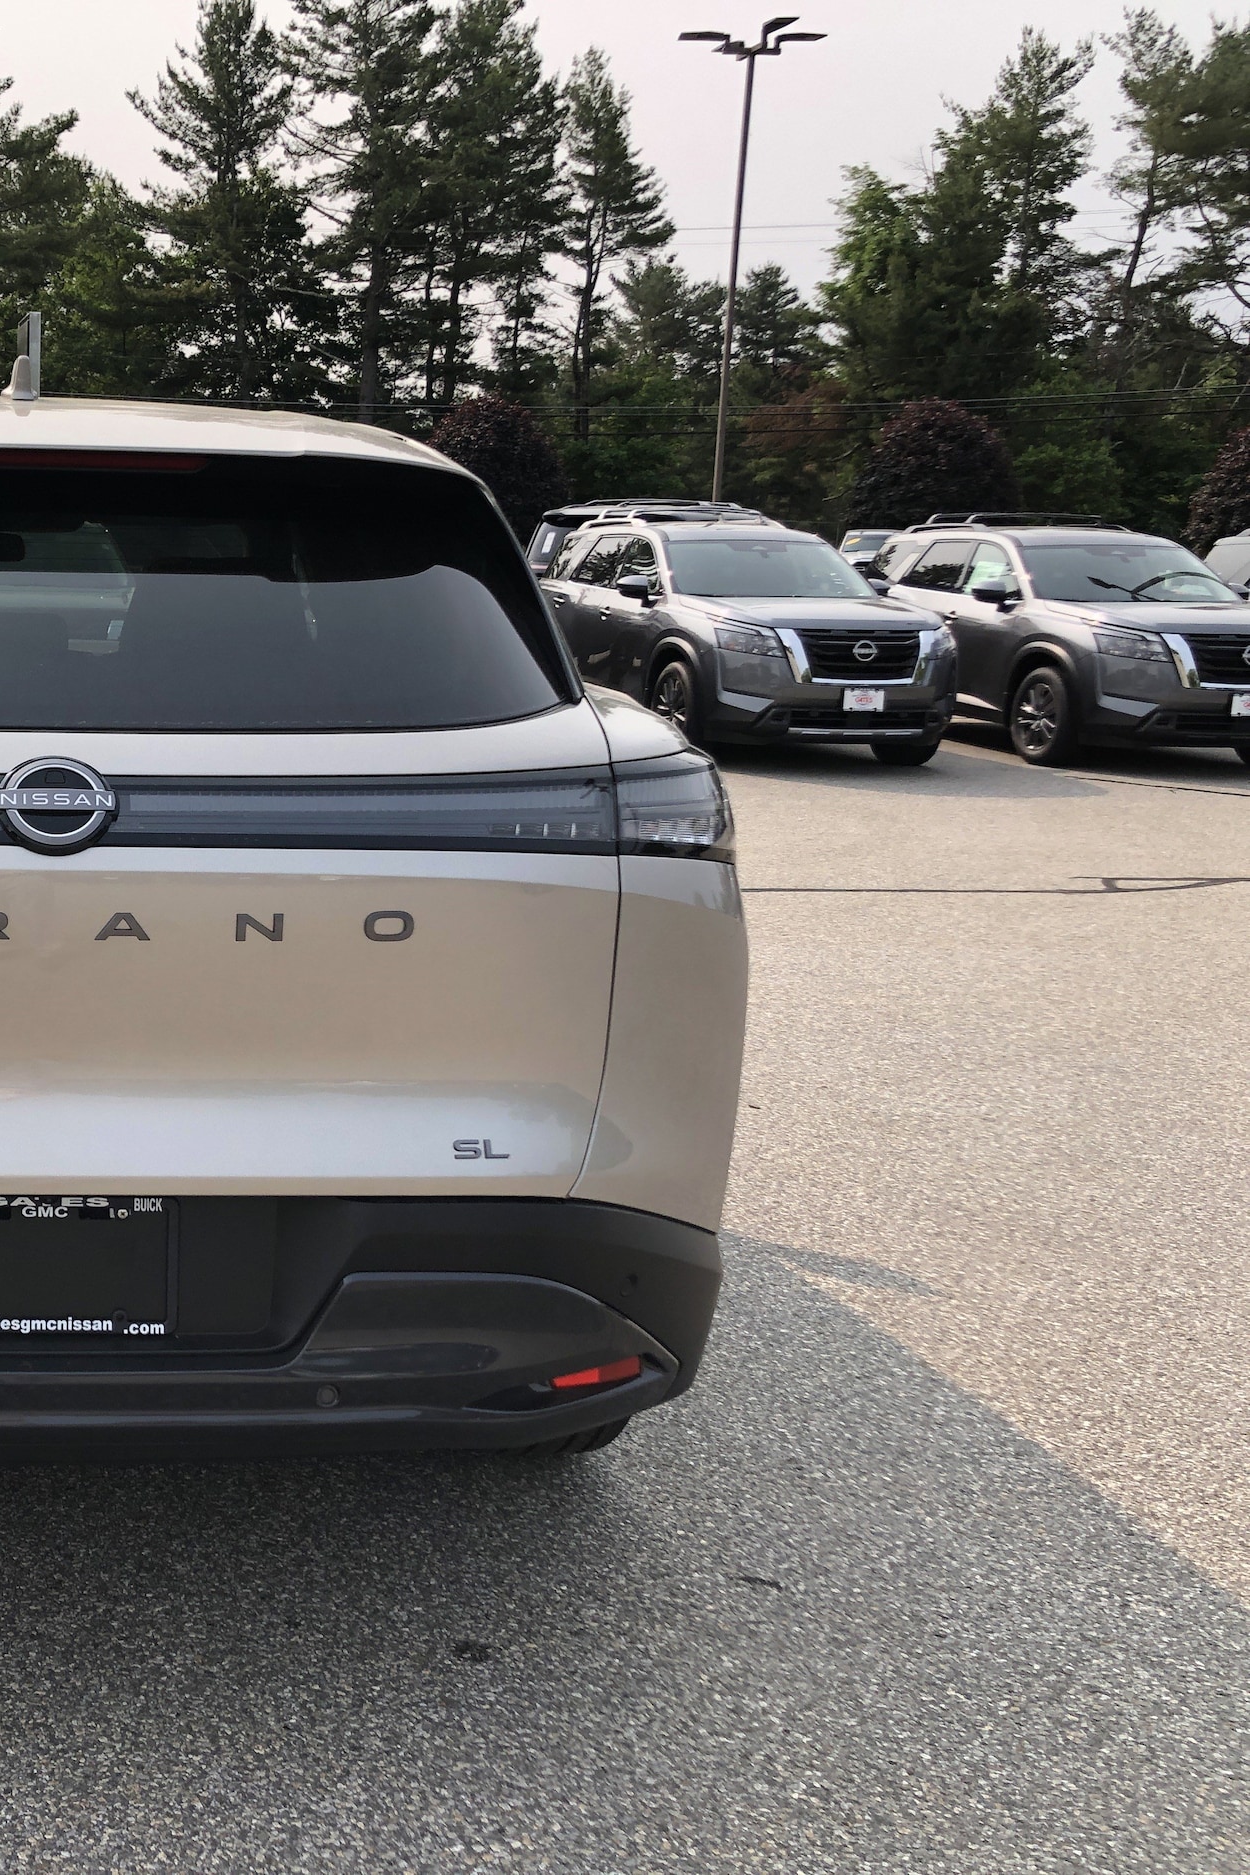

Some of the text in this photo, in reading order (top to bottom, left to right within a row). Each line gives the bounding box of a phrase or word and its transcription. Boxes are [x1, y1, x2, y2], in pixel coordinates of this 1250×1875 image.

[0, 793, 113, 807] NISSAN
[452, 1138, 510, 1160] SL
[133, 1197, 163, 1212] BUICK
[21, 1206, 69, 1219] GMC
[123, 1322, 166, 1335] .com
